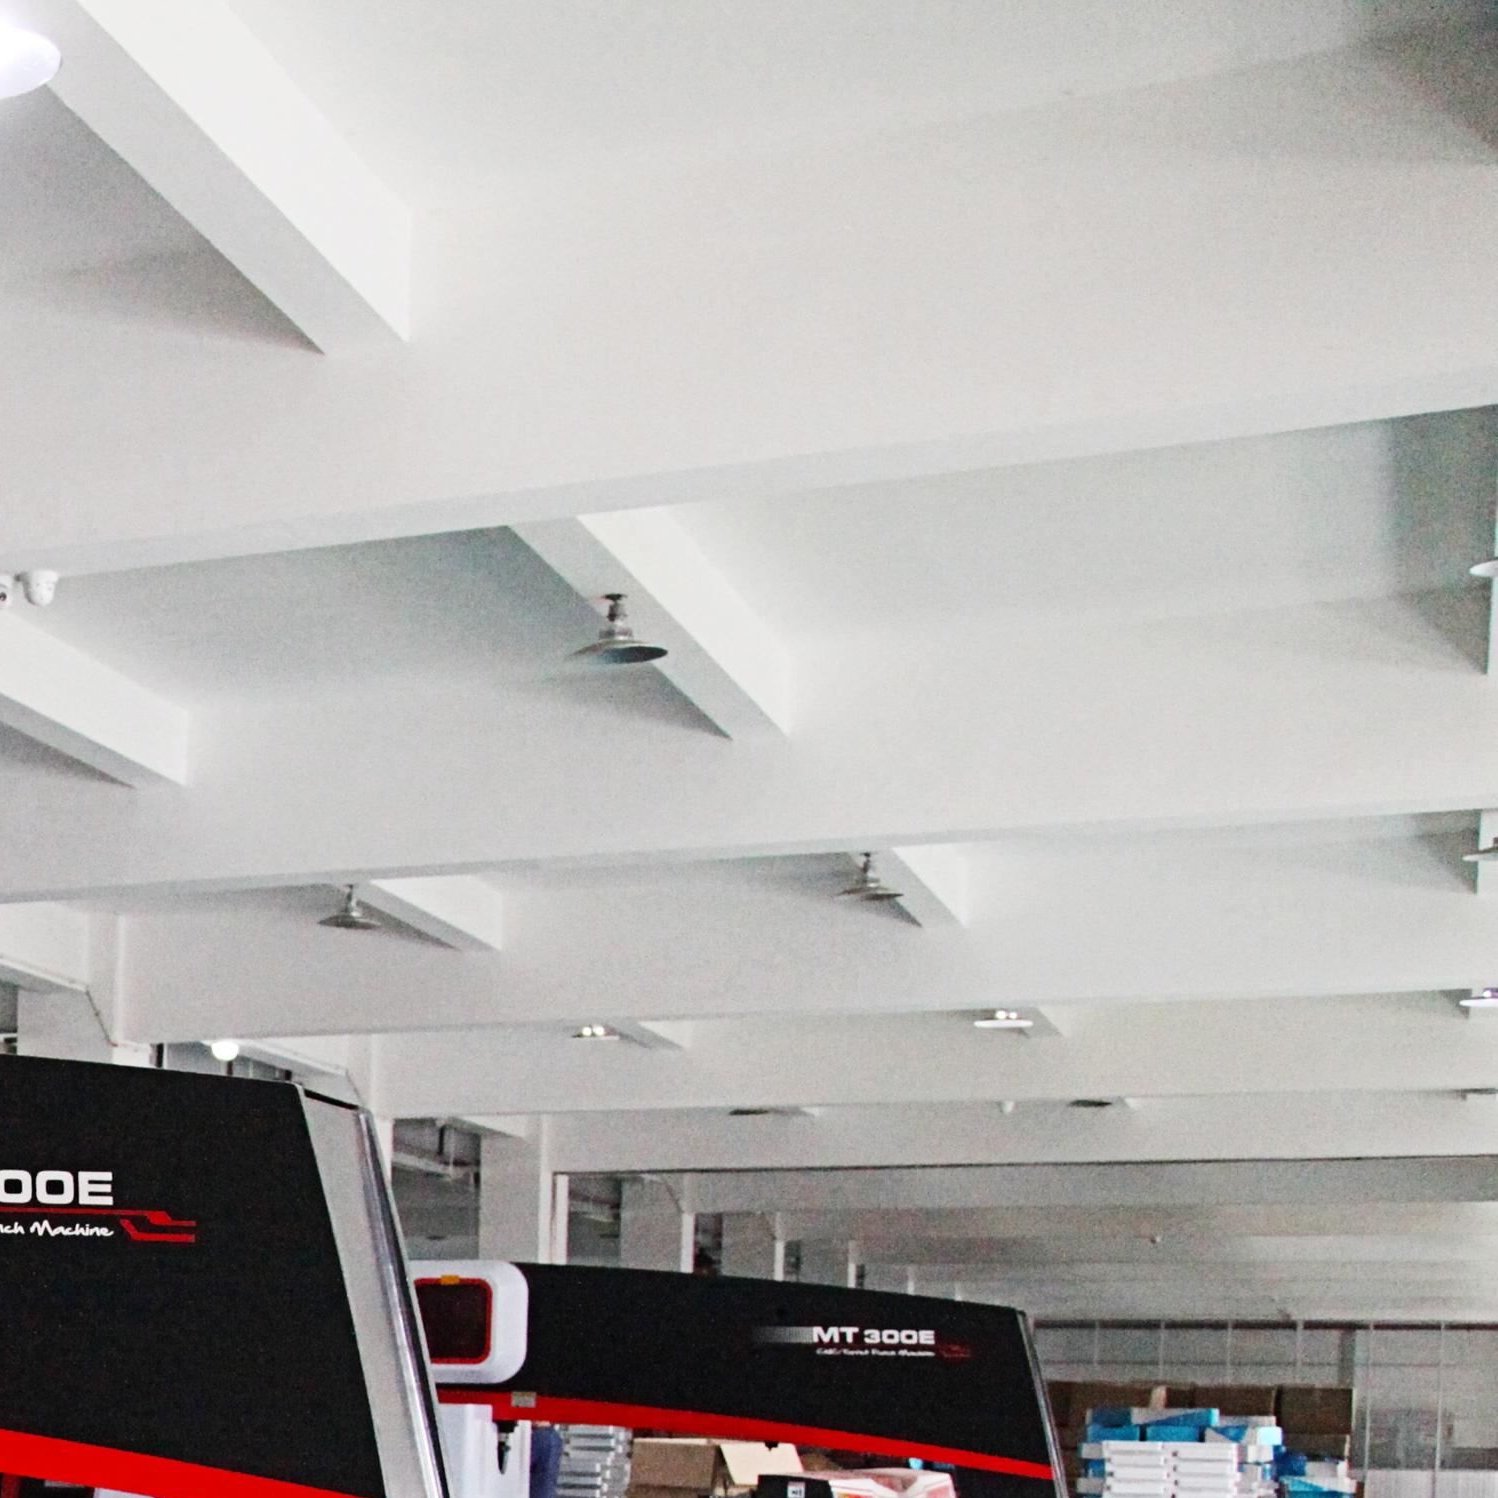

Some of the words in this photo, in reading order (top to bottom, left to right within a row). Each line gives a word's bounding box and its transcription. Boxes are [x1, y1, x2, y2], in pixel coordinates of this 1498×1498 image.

[29, 1219, 115, 1238] Machine
[812, 1326, 859, 1344] MT
[863, 1329, 936, 1345] 300E
